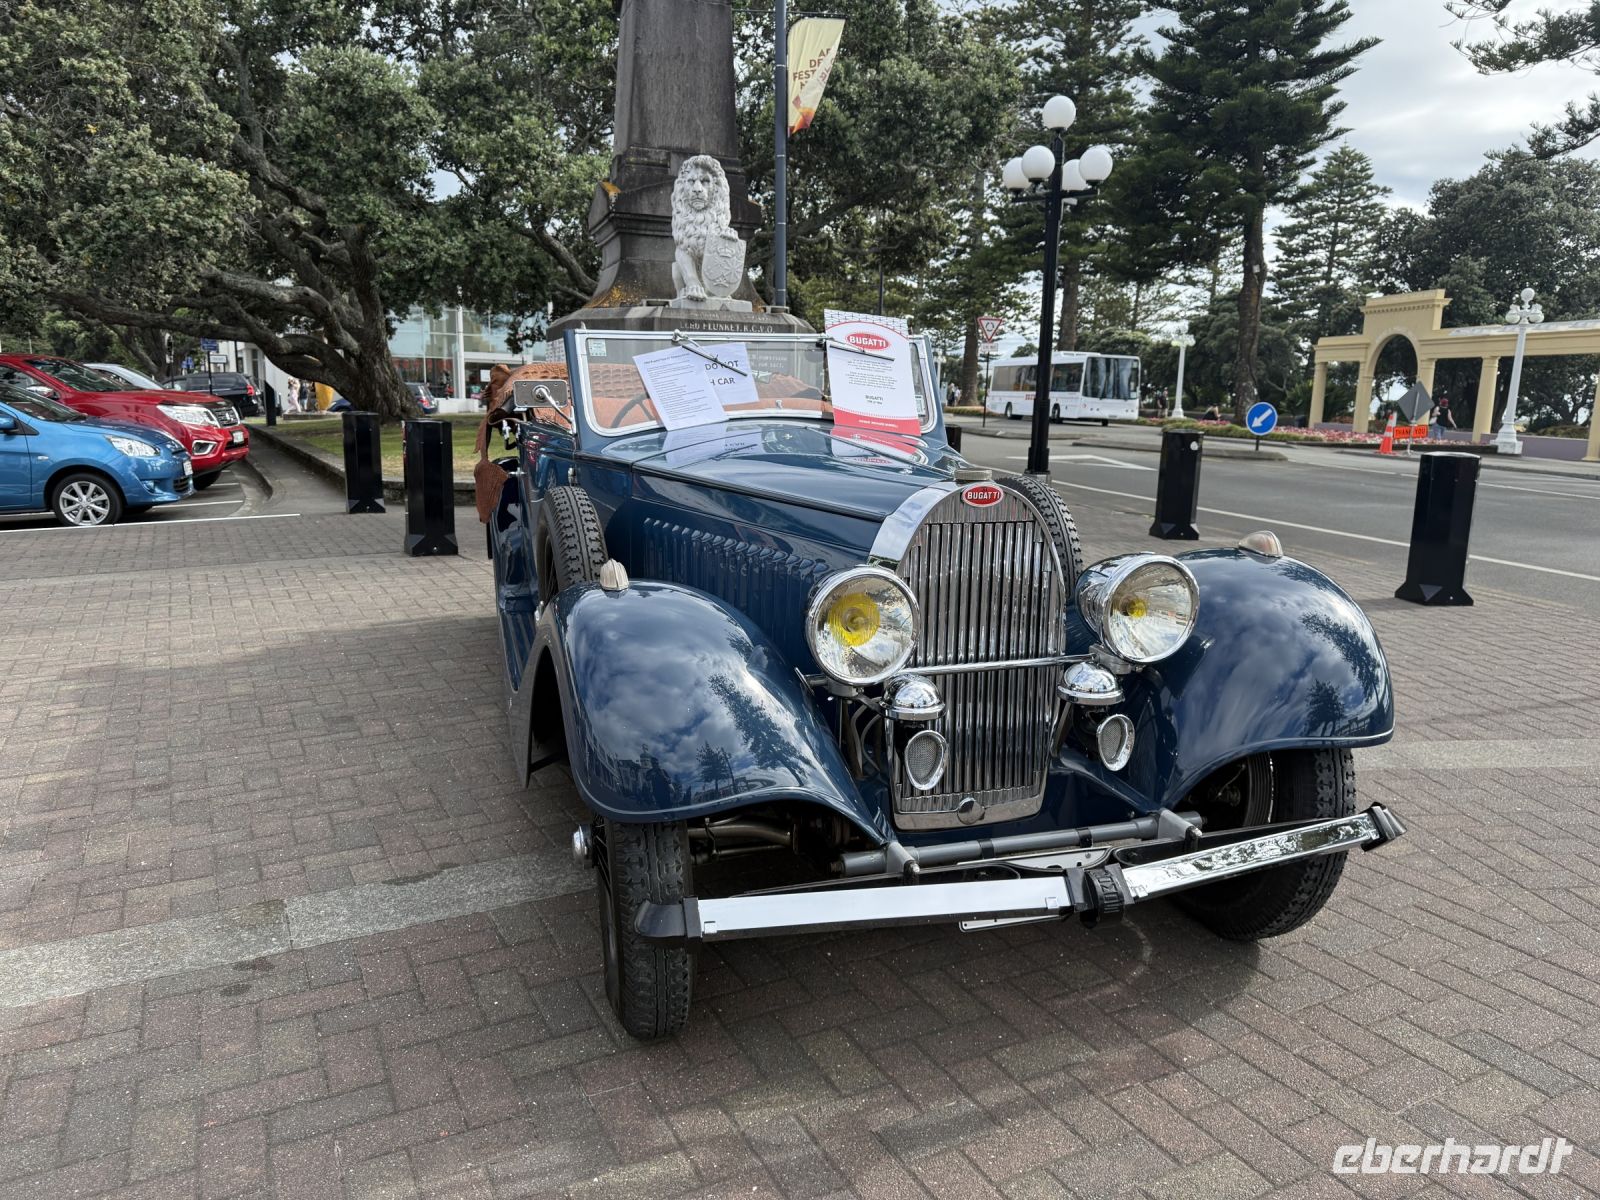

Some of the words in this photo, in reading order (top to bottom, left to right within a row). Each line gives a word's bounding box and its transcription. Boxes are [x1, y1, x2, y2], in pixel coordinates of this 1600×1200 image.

[849, 336, 886, 348] BUGATTI
[705, 363, 718, 371] DO
[717, 377, 736, 386] CAR
[967, 491, 1000, 500] BUGATTI
